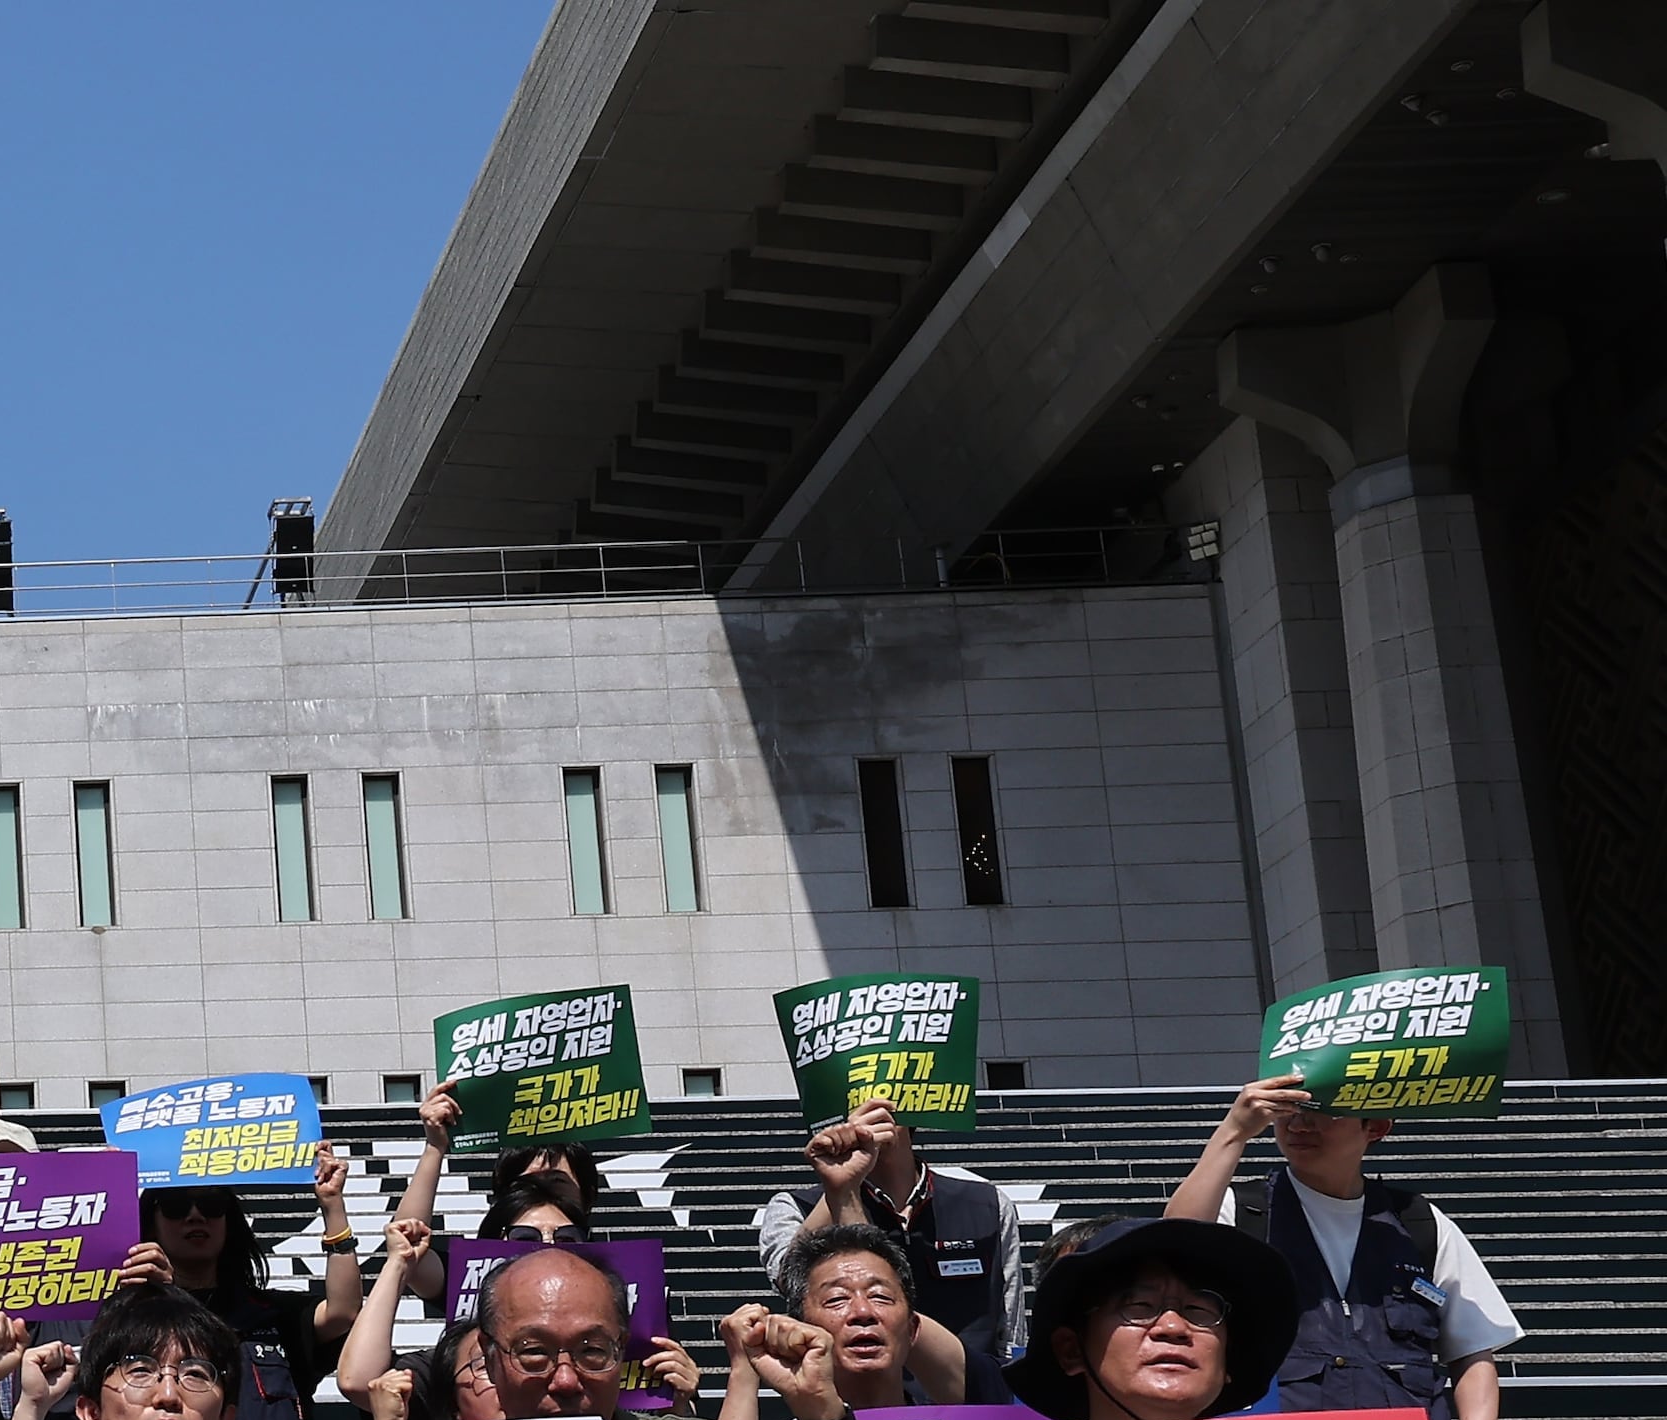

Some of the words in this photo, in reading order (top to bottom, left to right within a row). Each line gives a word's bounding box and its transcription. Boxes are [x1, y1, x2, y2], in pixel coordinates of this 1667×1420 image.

[450, 1011, 508, 1053] 영세
[791, 990, 842, 1036] 영세
[1268, 1009, 1399, 1059] 소상공인
[1402, 1004, 1473, 1039] 지원
[1279, 990, 1344, 1032] 영세
[446, 1033, 560, 1083] 소상공인
[563, 1022, 613, 1062] 지원
[794, 1013, 894, 1068] 소상공인
[898, 1011, 954, 1043] 지원
[1344, 1045, 1451, 1080] 국가가
[513, 1063, 601, 1105] 국가가
[1331, 1074, 1497, 1111] 책임져라!!
[114, 1104, 201, 1134] 플랫폼
[207, 1094, 297, 1122] 노동자
[505, 1087, 640, 1137] 책임져라!!
[181, 1119, 299, 1151] 최저임금
